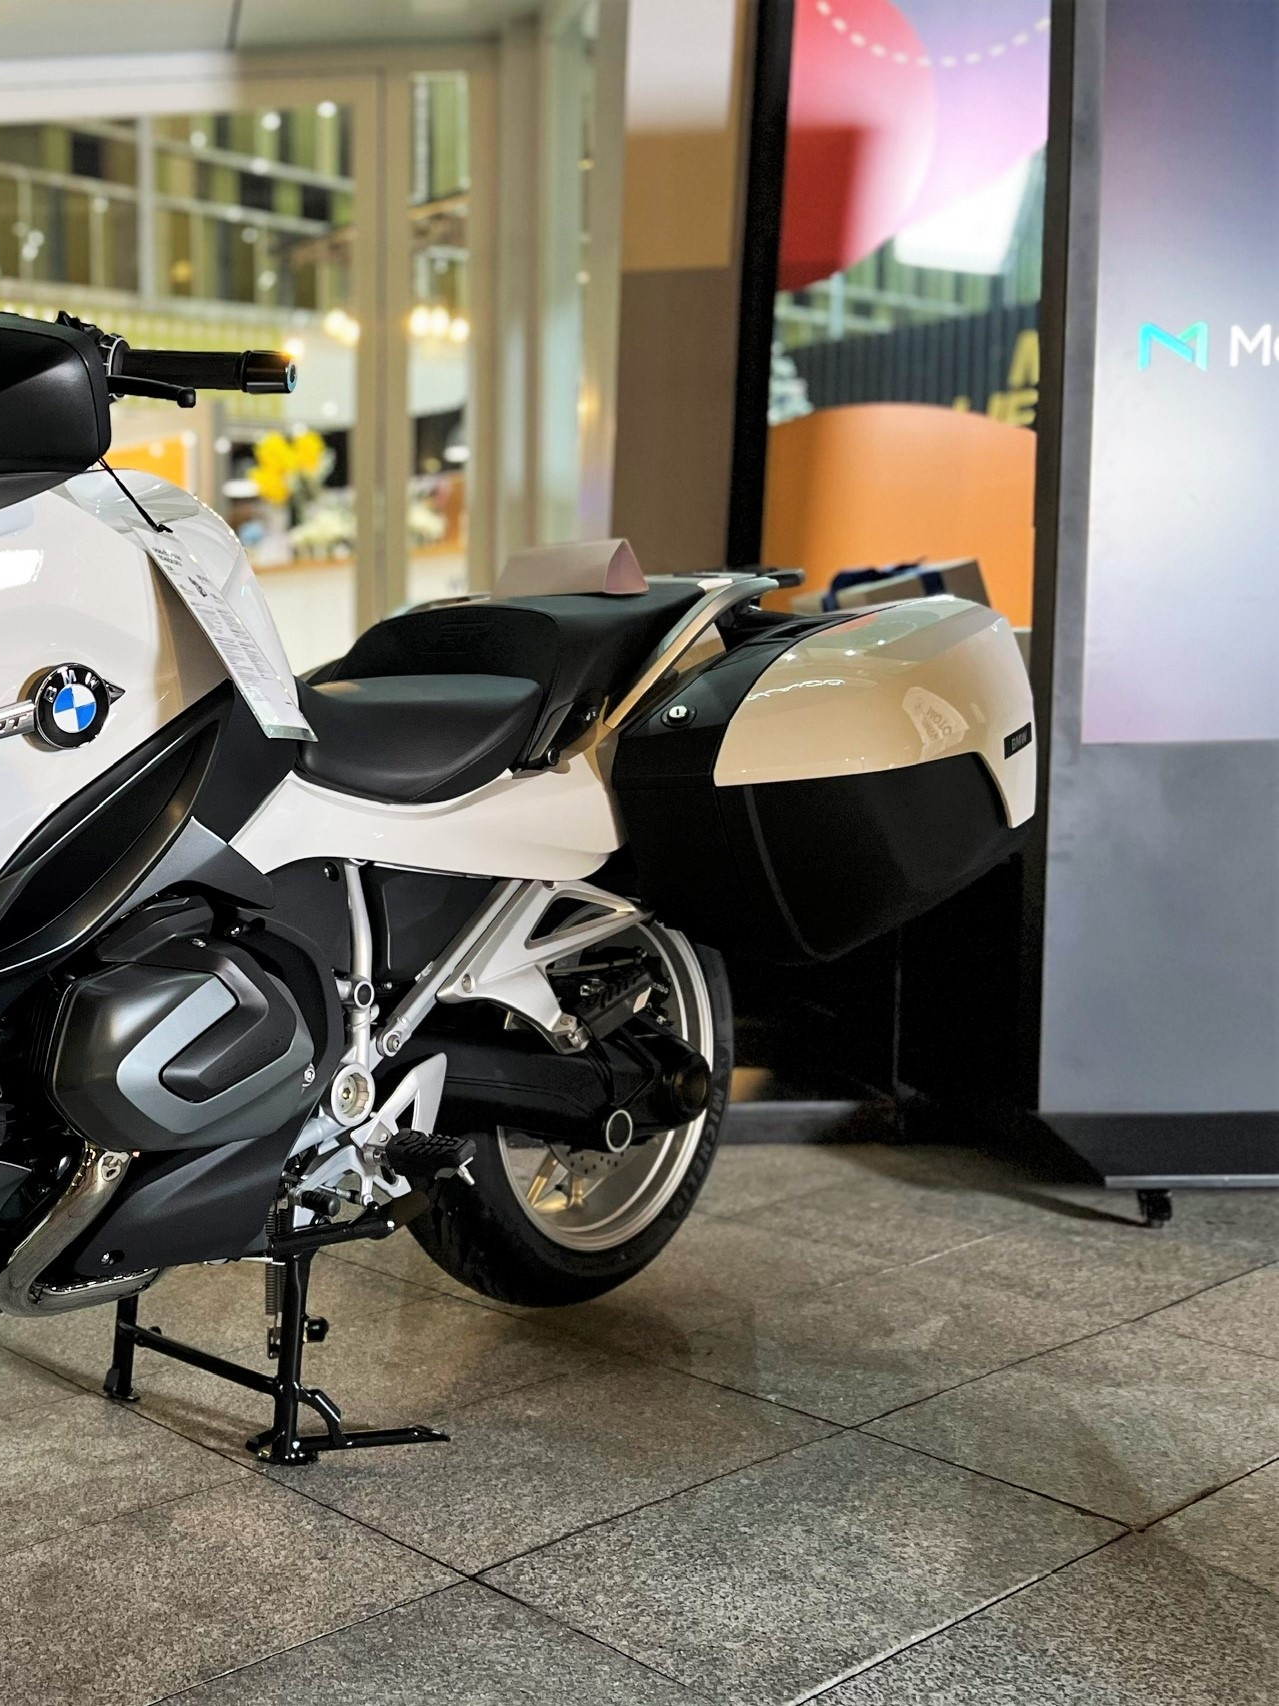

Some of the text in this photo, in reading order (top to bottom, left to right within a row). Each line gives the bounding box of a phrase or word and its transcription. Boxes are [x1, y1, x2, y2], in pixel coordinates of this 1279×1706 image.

[1229, 324, 1279, 368] M
[42, 668, 100, 703] BMW
[1011, 729, 1028, 751] BMW
[672, 1086, 725, 1217] MICHELIN
